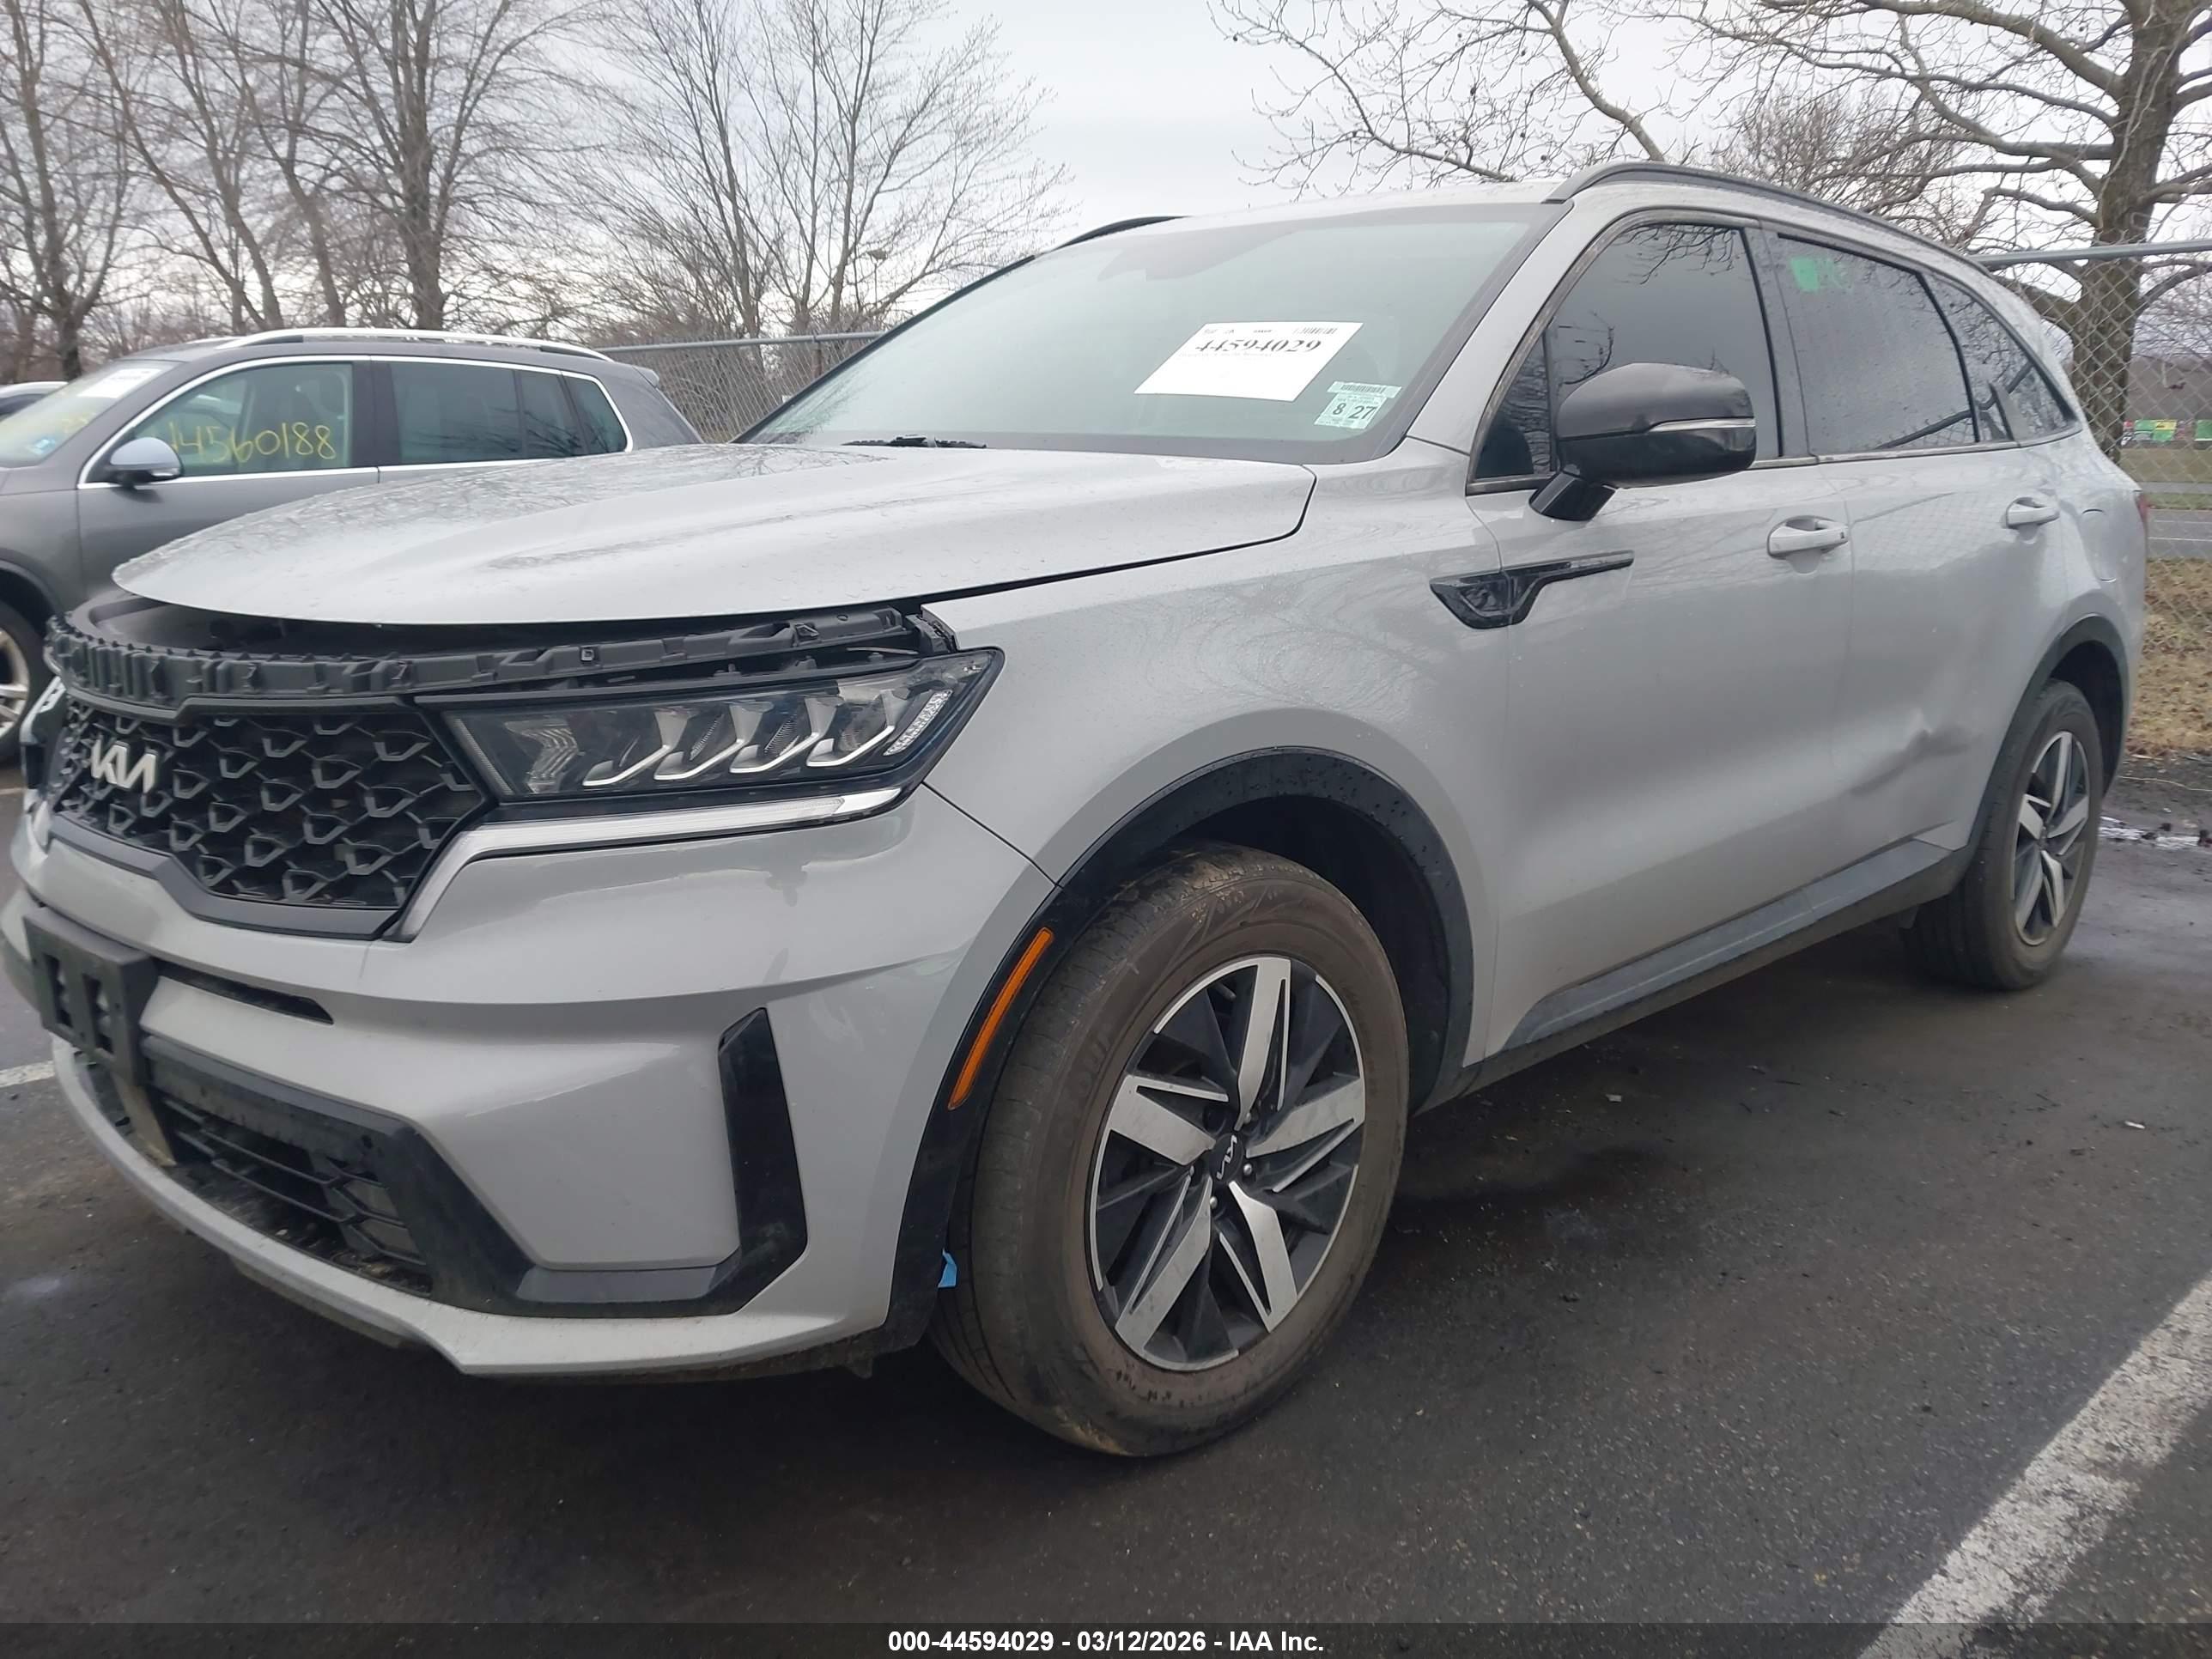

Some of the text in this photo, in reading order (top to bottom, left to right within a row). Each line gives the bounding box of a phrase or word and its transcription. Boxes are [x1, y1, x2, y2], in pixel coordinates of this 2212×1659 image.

[1194, 338, 1322, 353] 44594029
[1332, 402, 1377, 420] 8 27
